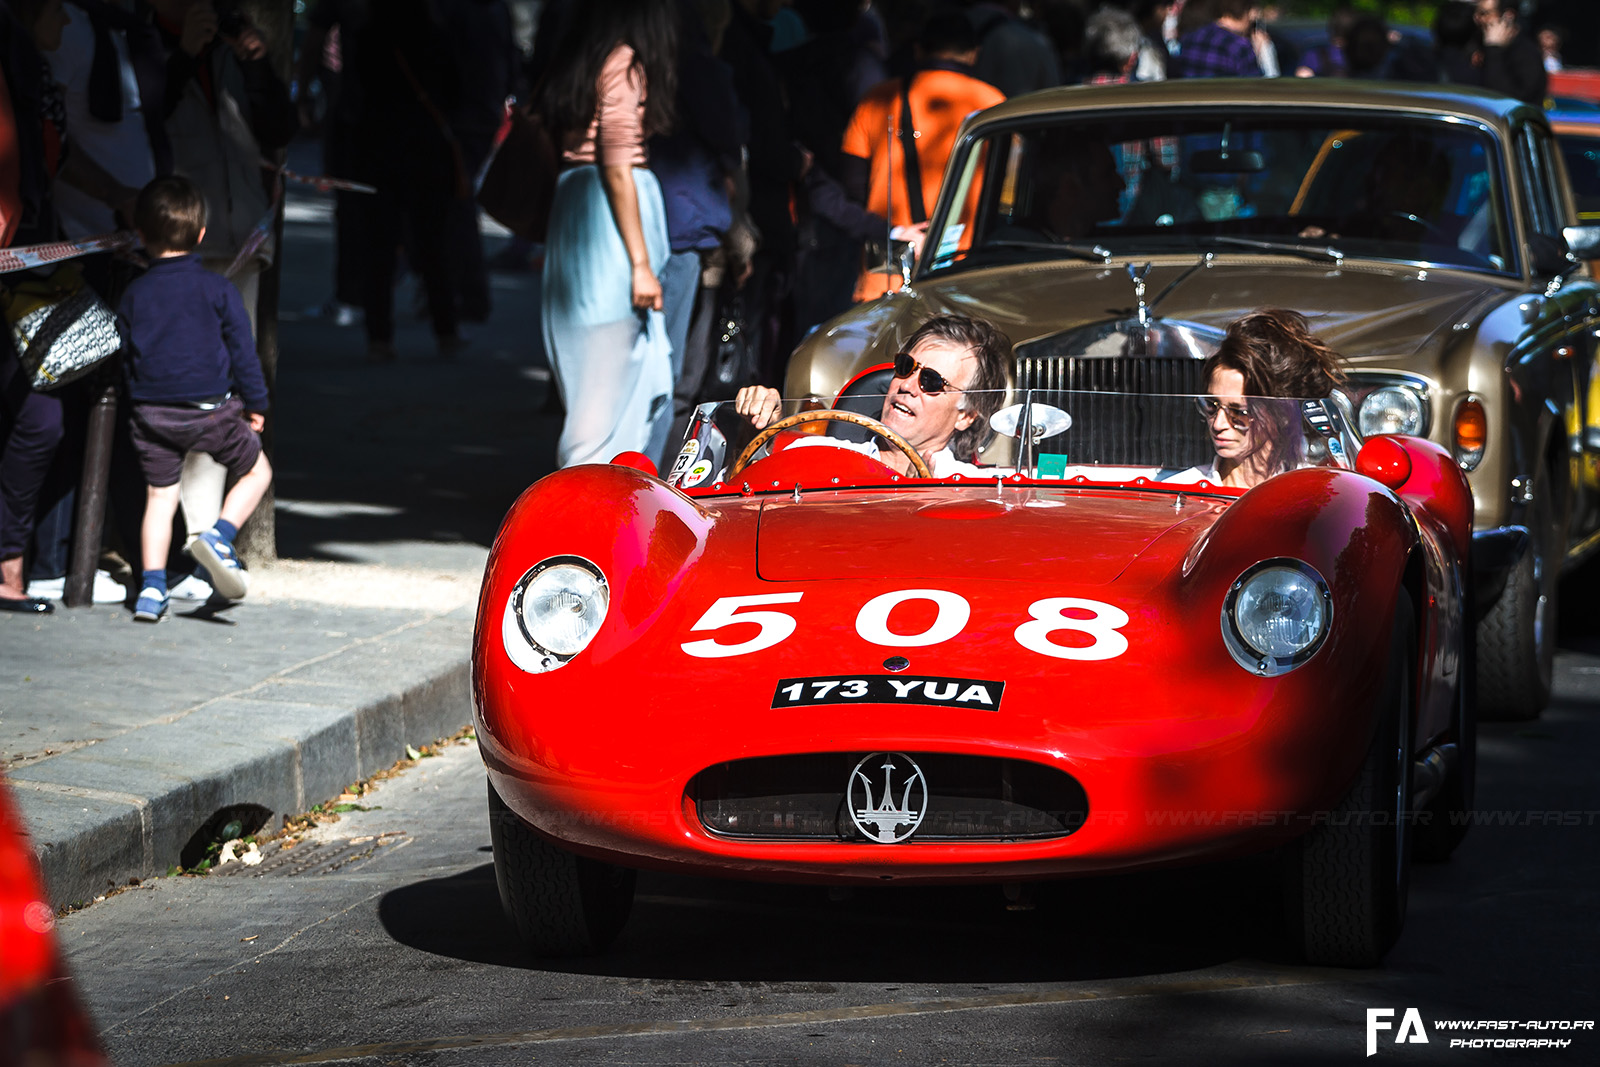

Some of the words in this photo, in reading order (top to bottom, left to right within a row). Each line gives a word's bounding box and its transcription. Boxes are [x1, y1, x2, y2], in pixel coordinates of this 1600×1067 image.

[681, 589, 1129, 661] 508
[781, 680, 869, 701] 173
[887, 681, 993, 705] YUA
